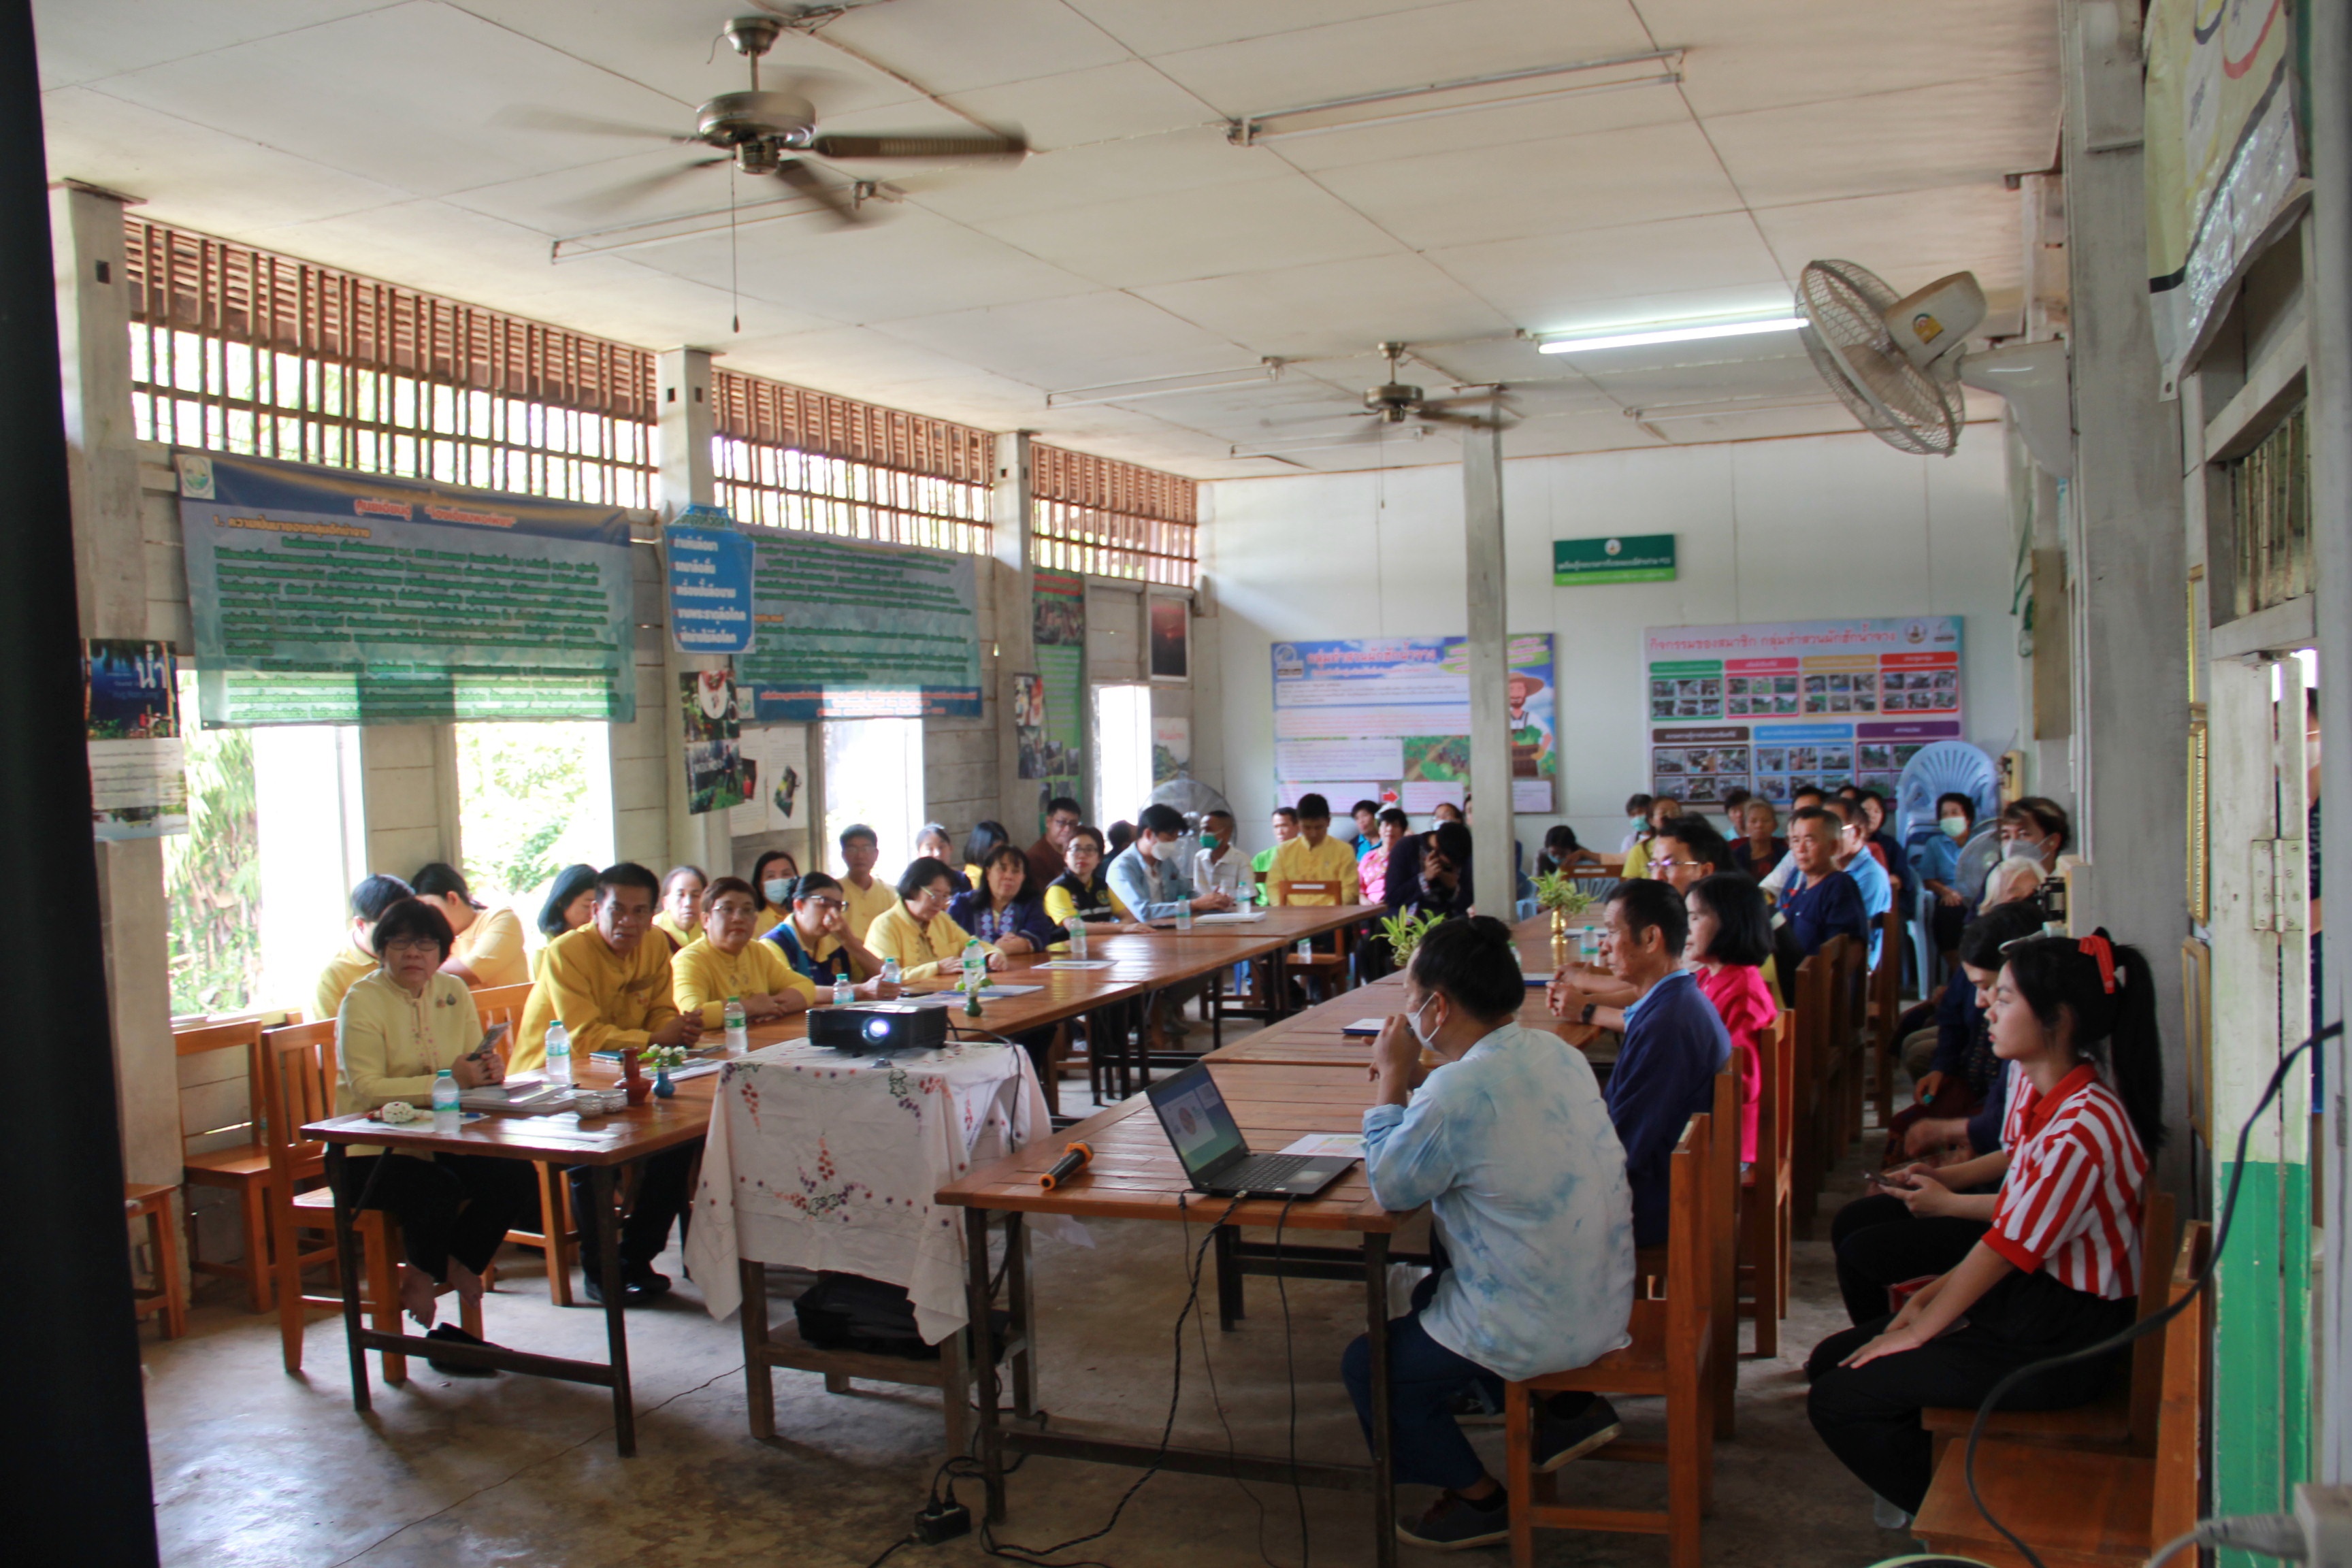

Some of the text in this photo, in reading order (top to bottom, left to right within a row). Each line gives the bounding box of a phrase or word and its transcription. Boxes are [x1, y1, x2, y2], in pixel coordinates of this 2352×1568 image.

[1649, 634, 1757, 651] กิจกรรมของสมาชิก
